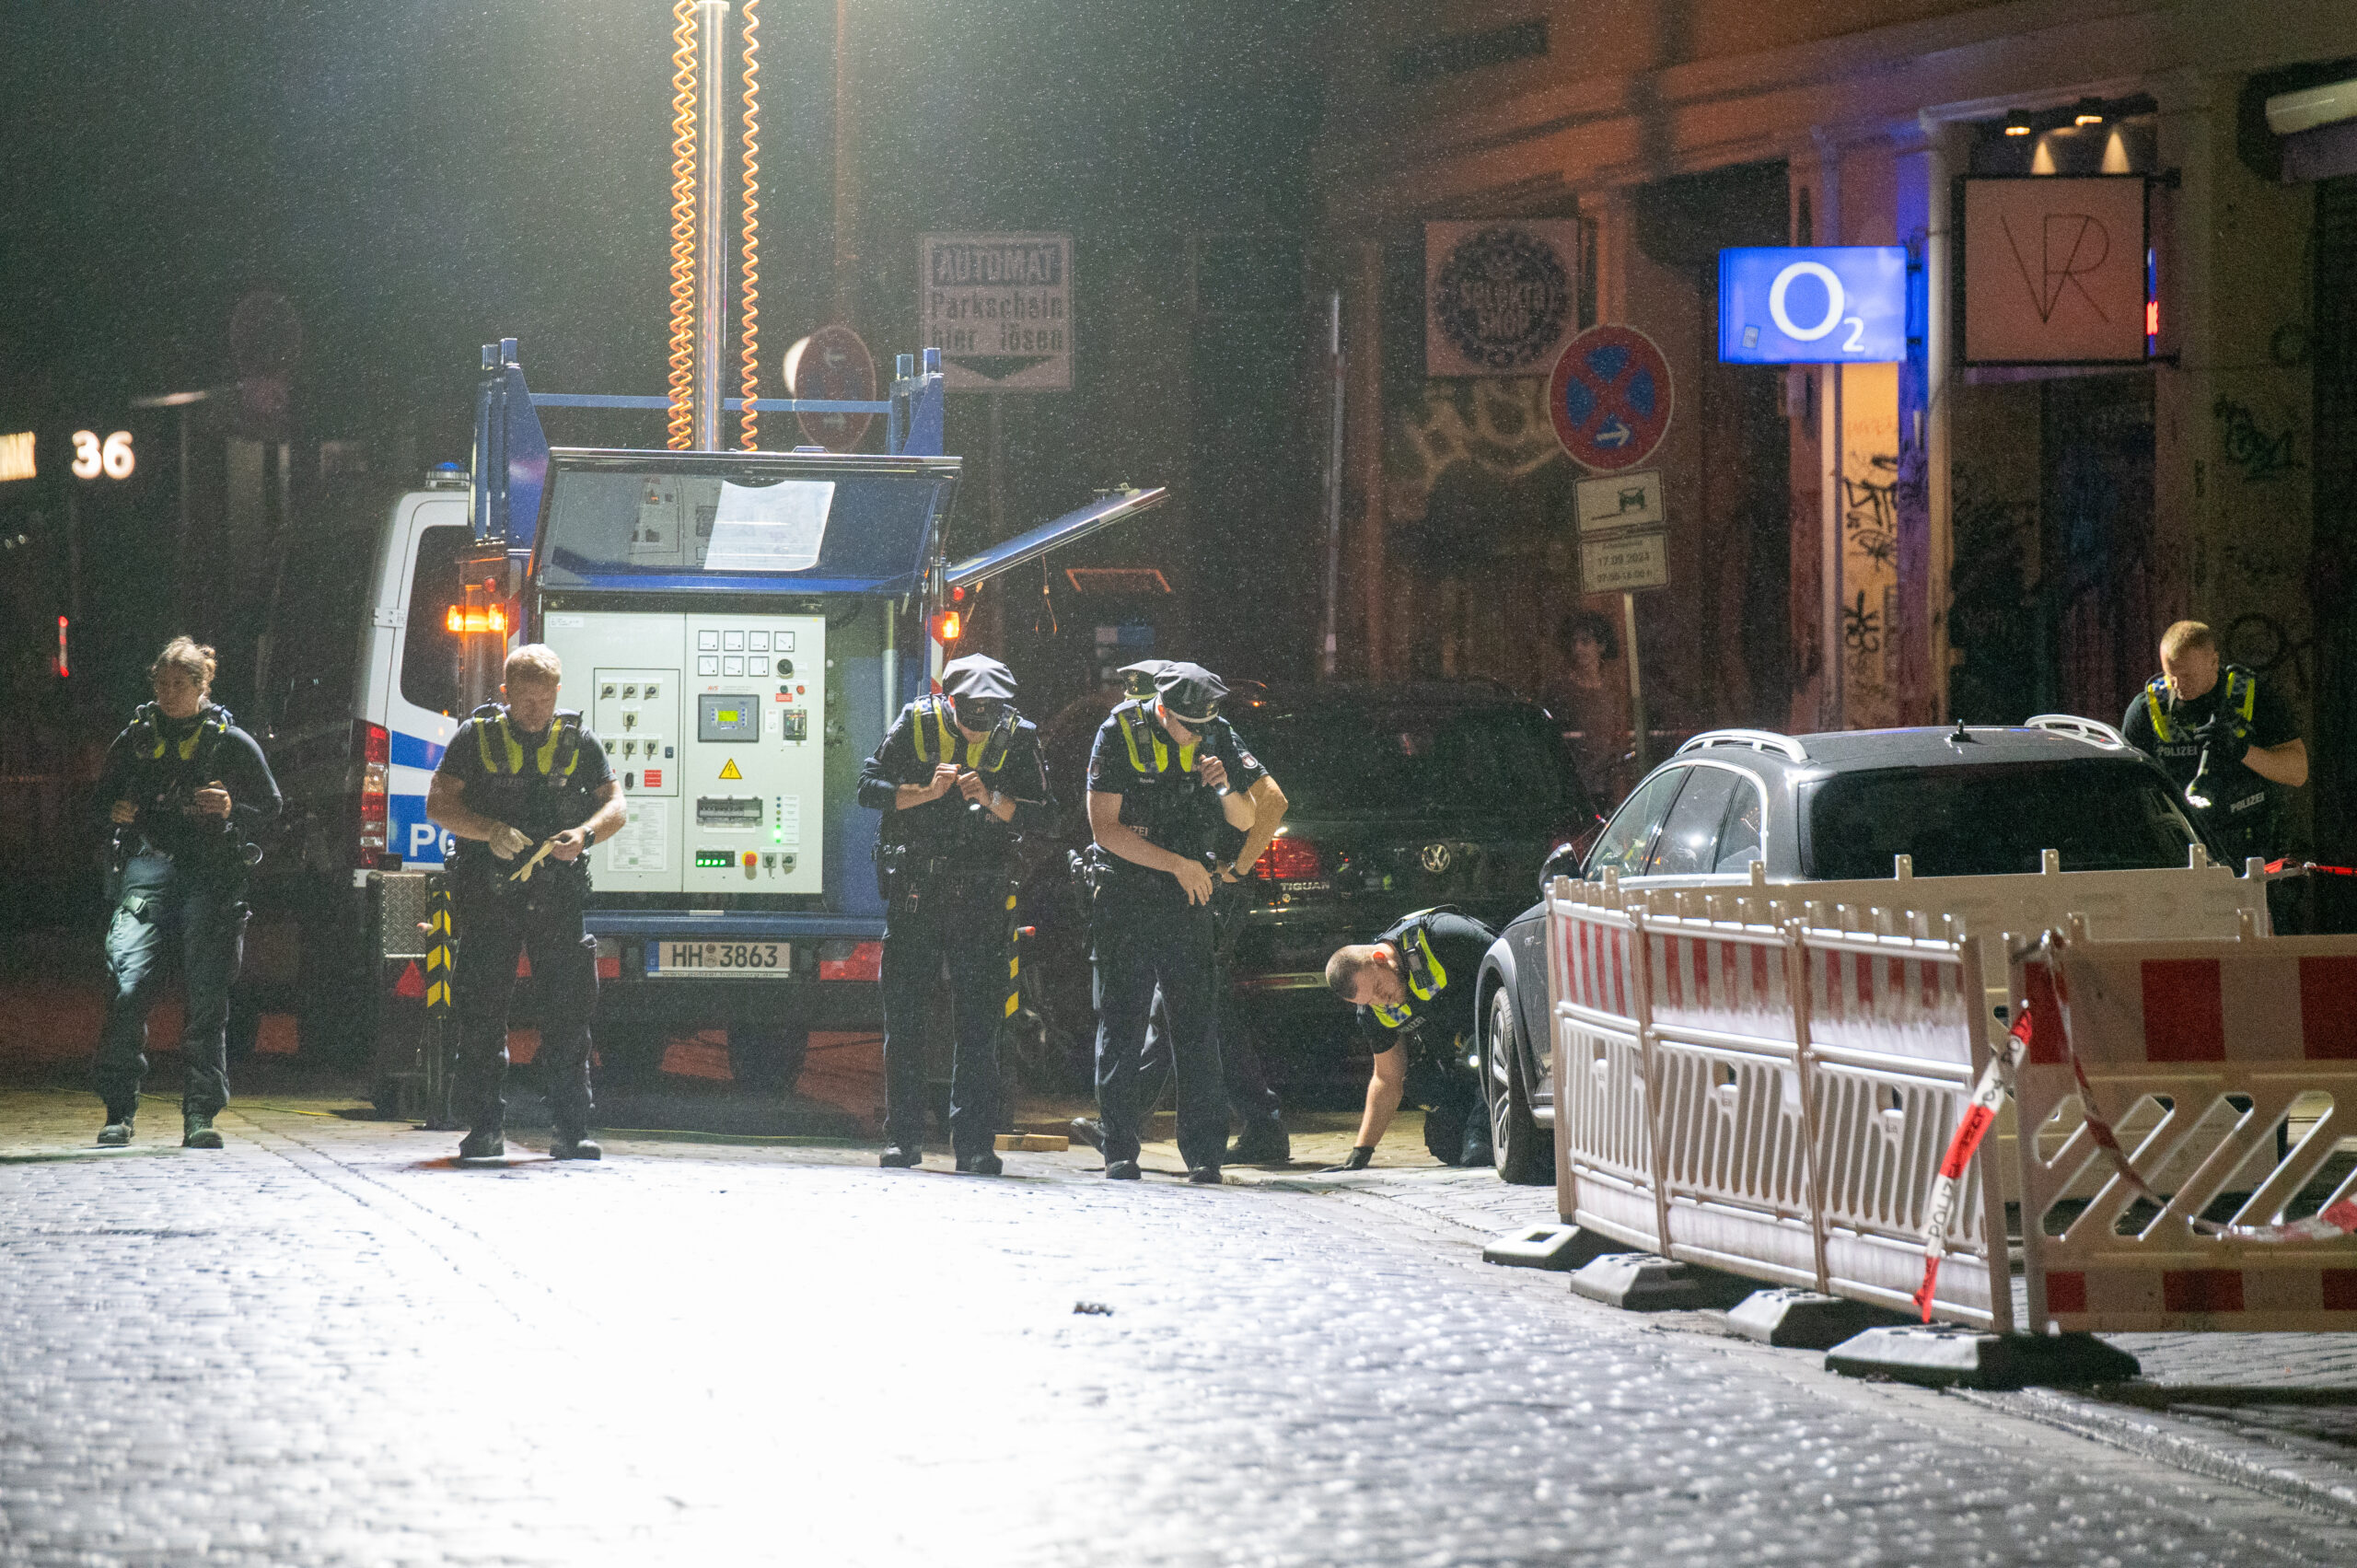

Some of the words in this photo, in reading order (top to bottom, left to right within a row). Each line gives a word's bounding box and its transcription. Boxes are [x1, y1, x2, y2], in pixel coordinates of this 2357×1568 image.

[937, 249, 1054, 281] AUTOMAT
[932, 289, 1062, 319] Parkschein
[1000, 322, 1062, 352] lösen
[72, 429, 135, 480] 36
[2229, 792, 2265, 814] POLIZEI
[1280, 880, 1330, 891] TIGUAN
[672, 944, 703, 968] HH
[719, 945, 778, 968] 3863
